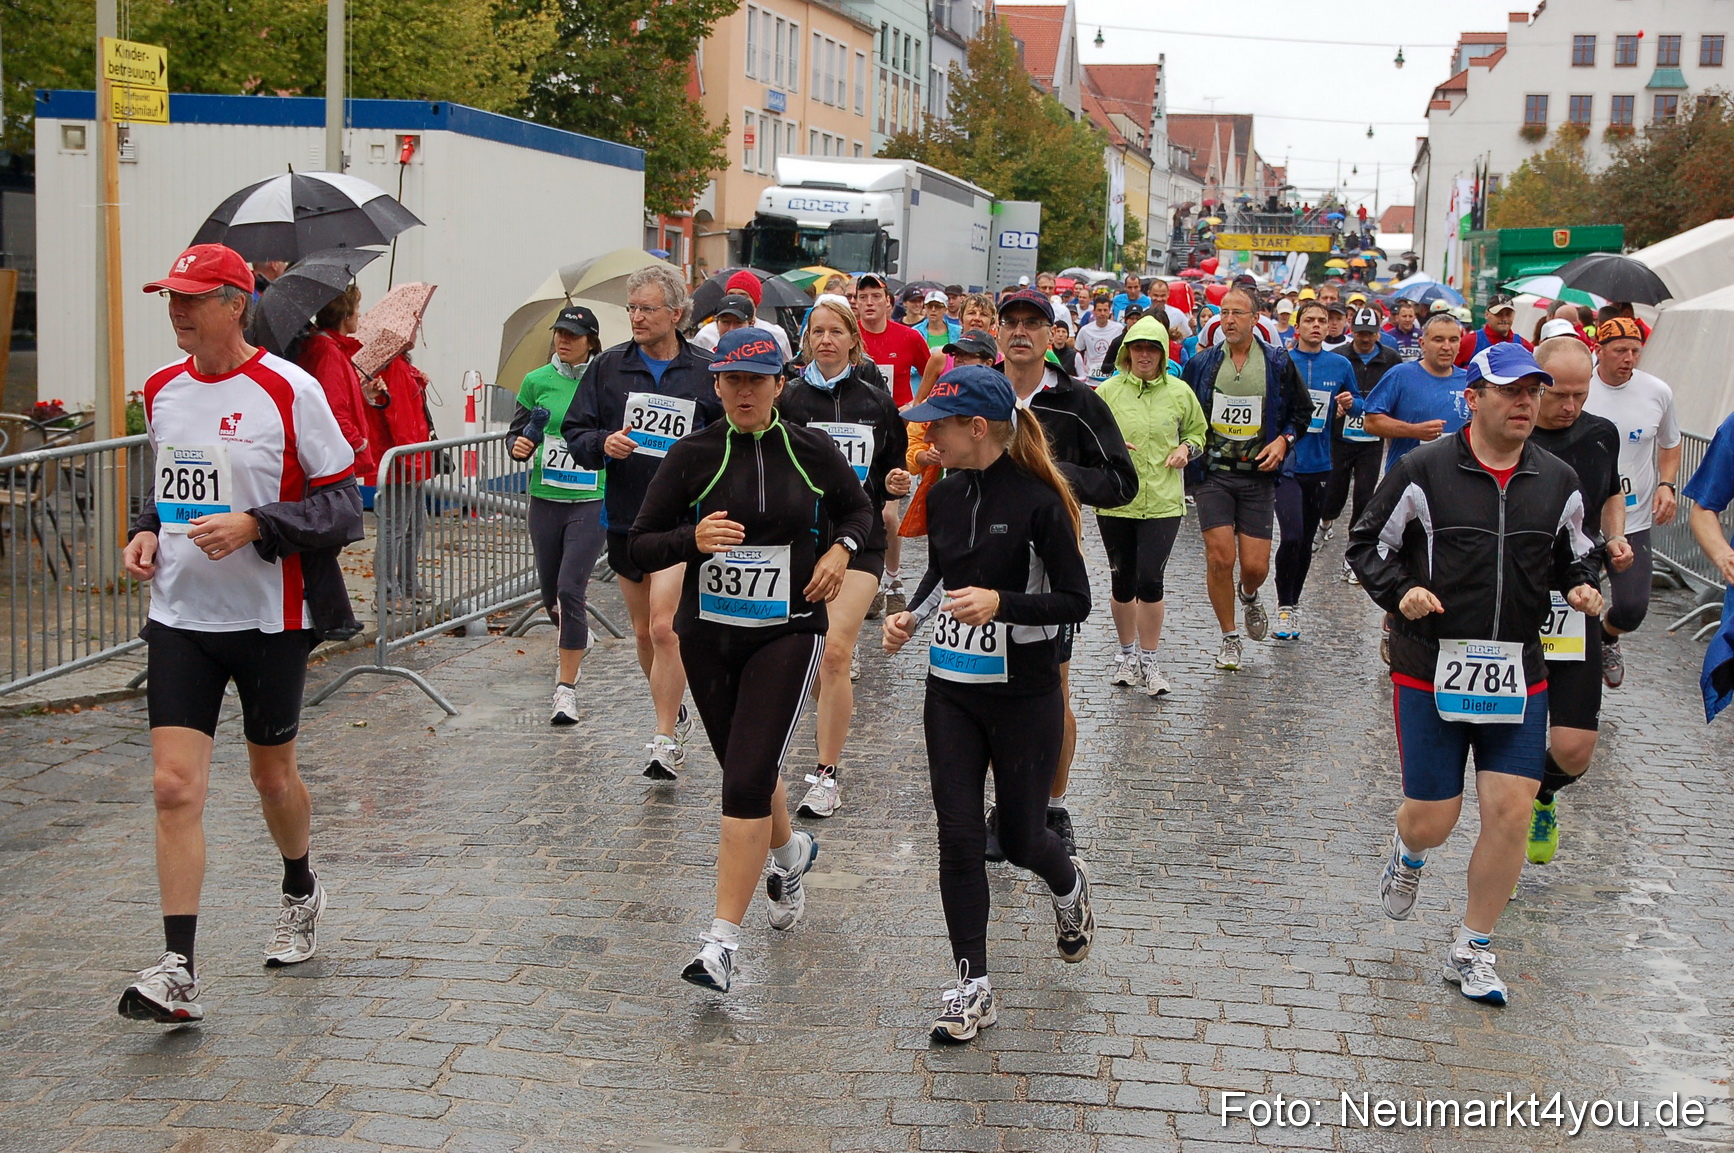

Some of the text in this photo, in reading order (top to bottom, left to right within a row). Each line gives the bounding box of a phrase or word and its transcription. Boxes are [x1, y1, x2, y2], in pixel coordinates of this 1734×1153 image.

[115, 43, 150, 61] Kinder-
[109, 60, 156, 84] betreuung
[788, 198, 849, 213] BOCK
[1251, 237, 1291, 248] START
[712, 340, 777, 368] OXYGEN
[630, 407, 687, 438] 3246
[1221, 407, 1252, 424] 429
[1228, 427, 1242, 435] Kurt
[642, 437, 667, 449] Josef
[174, 449, 204, 459] BOCK
[161, 467, 220, 501] 2681
[558, 473, 578, 482] Petra
[725, 551, 762, 559] BOCK
[707, 564, 781, 598] 3377
[713, 597, 774, 616] SUSANN
[935, 613, 997, 653] 3378
[1466, 644, 1501, 655] BOCK
[937, 650, 988, 670] BIRGIT
[1444, 661, 1518, 693] 2784
[1462, 698, 1498, 711] Dieter
